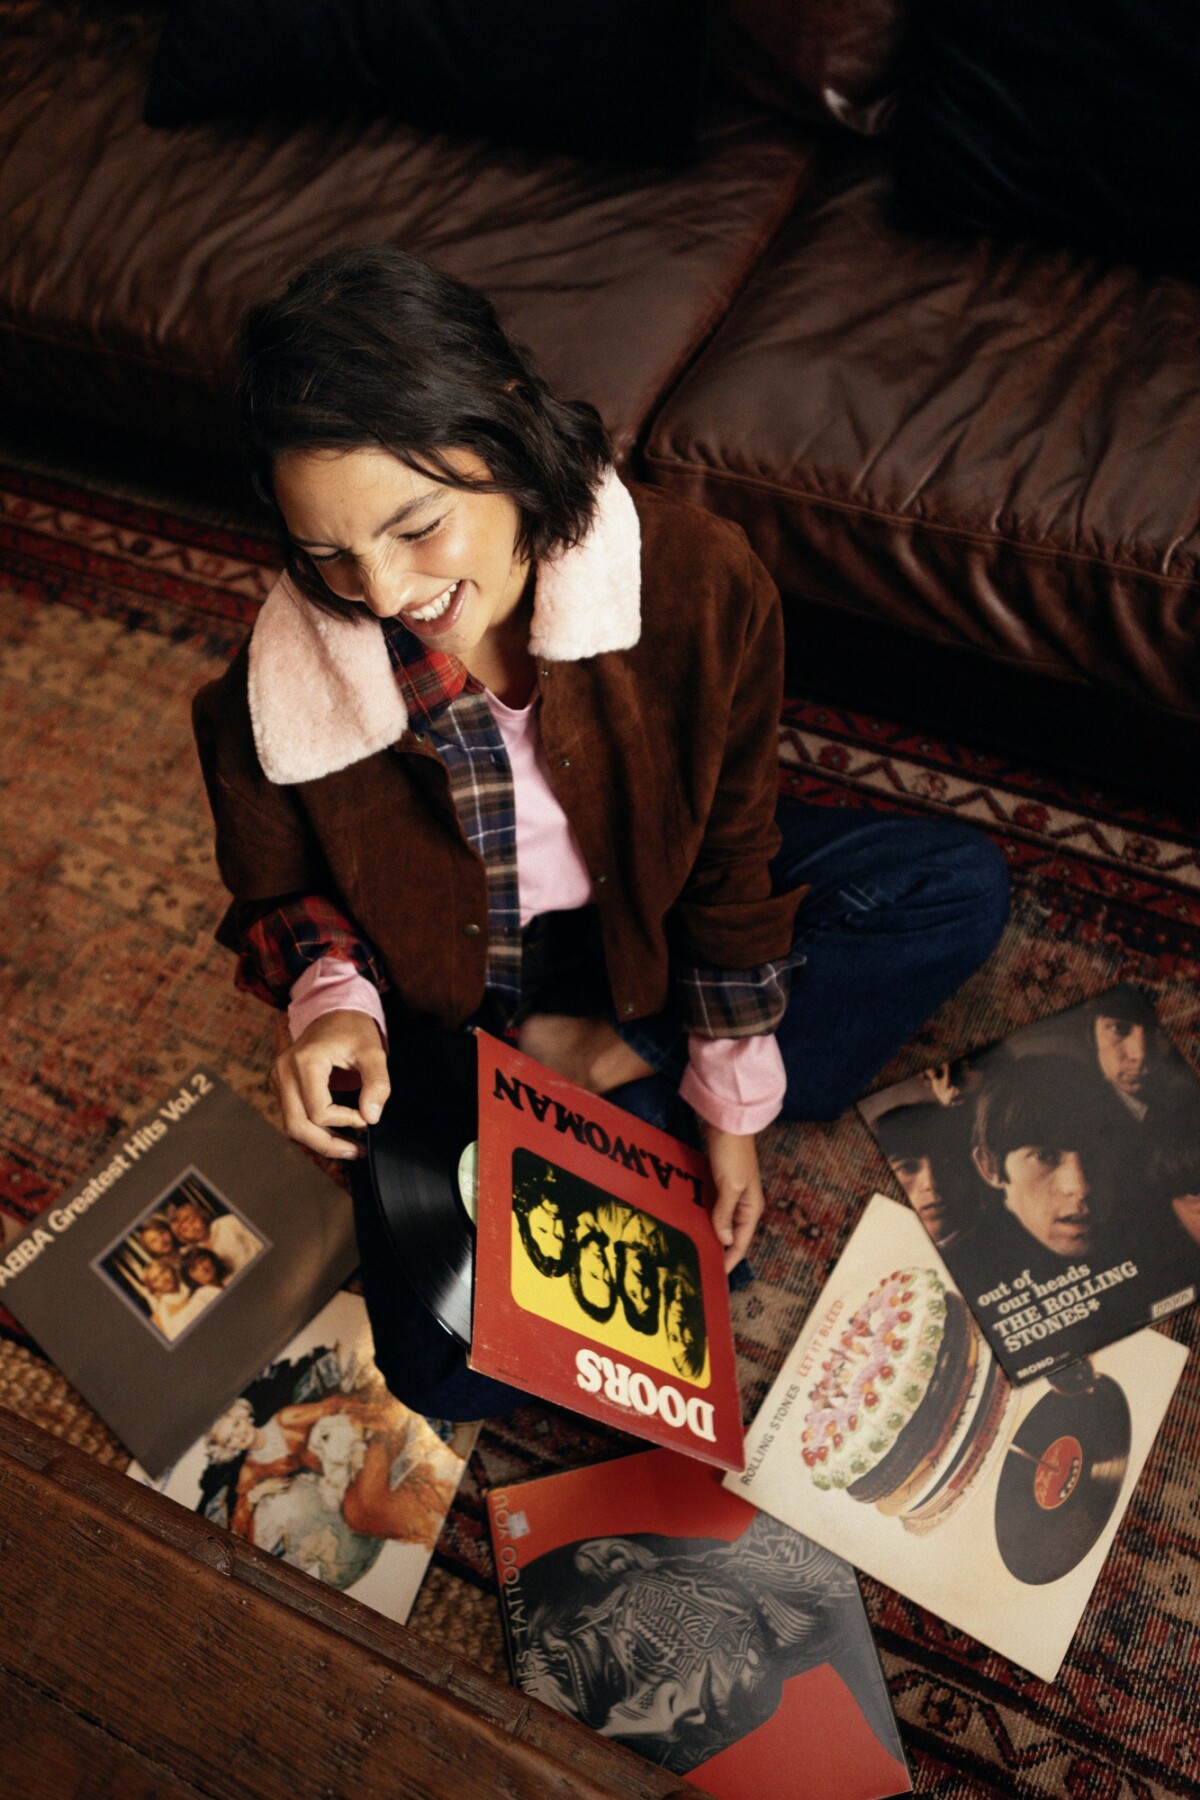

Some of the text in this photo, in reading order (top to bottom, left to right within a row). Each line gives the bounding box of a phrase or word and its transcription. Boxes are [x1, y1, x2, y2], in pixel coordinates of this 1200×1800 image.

[0, 1228, 54, 1287] ABBA
[48, 1154, 132, 1232] Greatest
[123, 1119, 168, 1160] Hits
[191, 1073, 214, 1095] 2
[978, 1268, 1034, 1307] out of
[993, 1305, 1042, 1337] THE
[1042, 1260, 1139, 1315] ROLLING
[997, 1264, 1091, 1314] our heads
[575, 1349, 717, 1442] DOORS
[740, 1300, 844, 1486] ROLLING STONES LET IT BLEED
[1016, 1356, 1054, 1379] MONO
[493, 1494, 511, 1540] YOU
[500, 1545, 528, 1638] TATTOO
